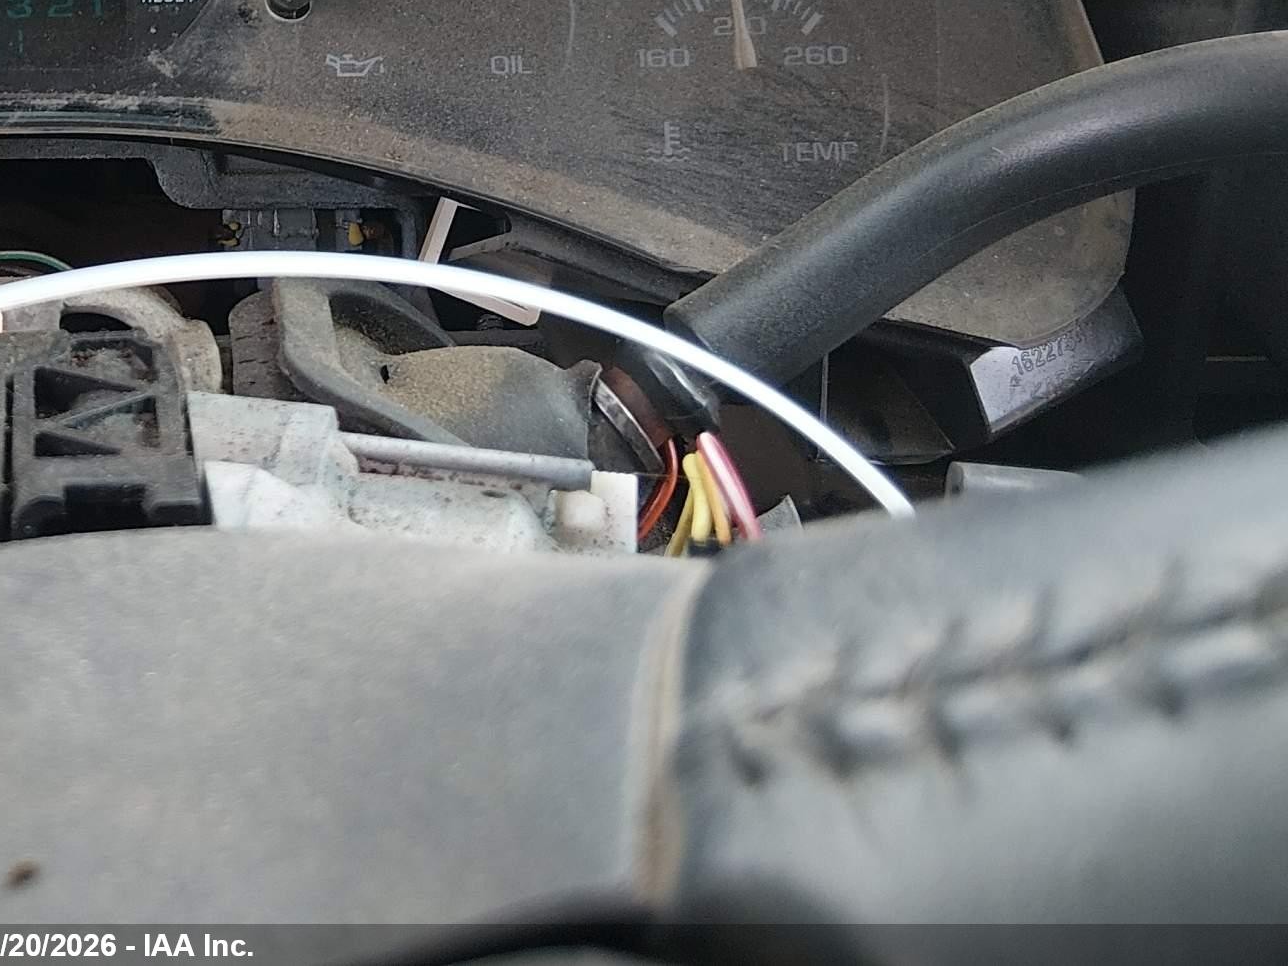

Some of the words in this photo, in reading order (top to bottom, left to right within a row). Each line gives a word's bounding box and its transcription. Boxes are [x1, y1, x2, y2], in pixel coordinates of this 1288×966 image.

[713, 16, 767, 35] 20
[490, 55, 532, 75] OIL
[637, 48, 690, 67] 160
[783, 45, 848, 66] 260
[782, 142, 859, 162] TEMP
